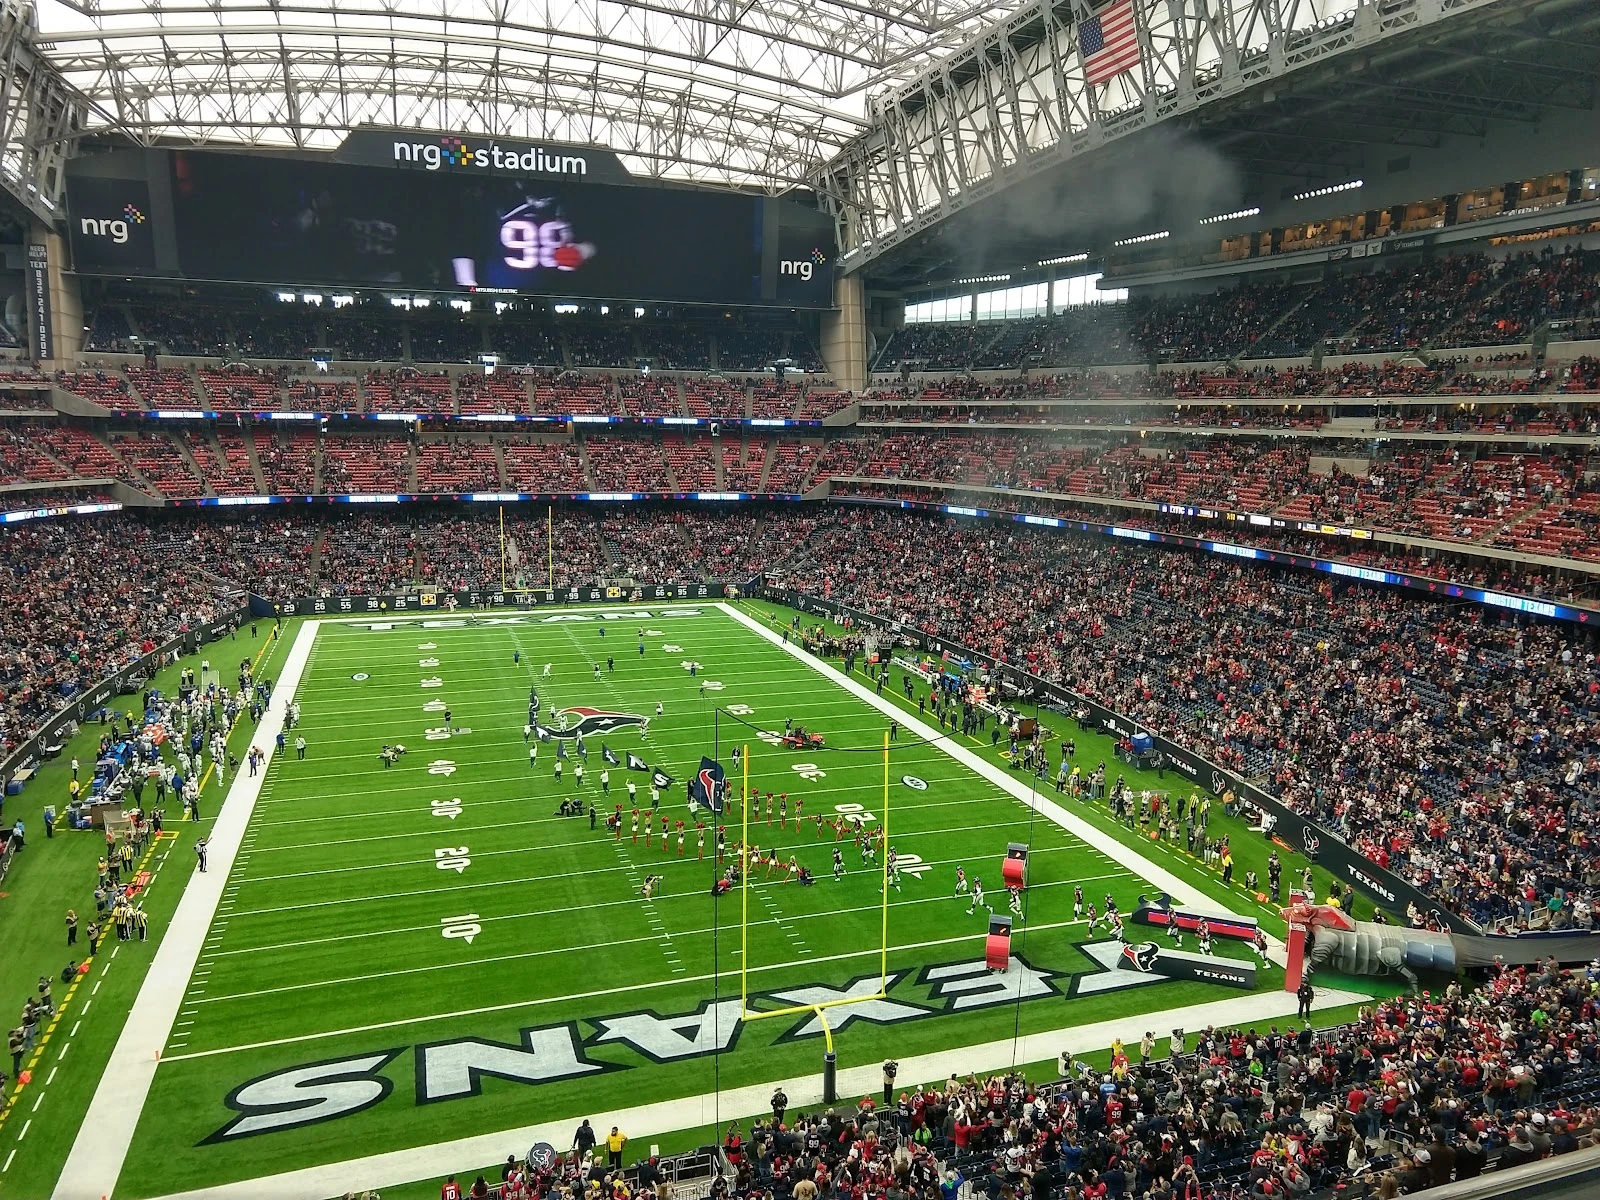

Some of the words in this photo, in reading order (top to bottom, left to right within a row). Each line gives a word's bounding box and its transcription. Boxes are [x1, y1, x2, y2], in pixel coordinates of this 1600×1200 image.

[394, 141, 441, 170] nrg
[475, 147, 586, 175] stadium
[81, 218, 128, 243] nrg
[29, 261, 47, 269] TEXT
[780, 260, 813, 281] nrg
[1166, 752, 1199, 776] TEXANS
[431, 797, 463, 816] 30
[834, 803, 877, 822] 20
[435, 846, 471, 869] 20
[1347, 864, 1396, 902] TEXANS
[440, 913, 482, 939] 10
[1193, 968, 1246, 983] TEXANS
[200, 938, 1170, 1142] TEXANS
[1274, 1040, 1281, 1049] 10
[1111, 1110, 1121, 1118] 99
[808, 1139, 819, 1149] 99
[446, 1190, 456, 1200] 10
